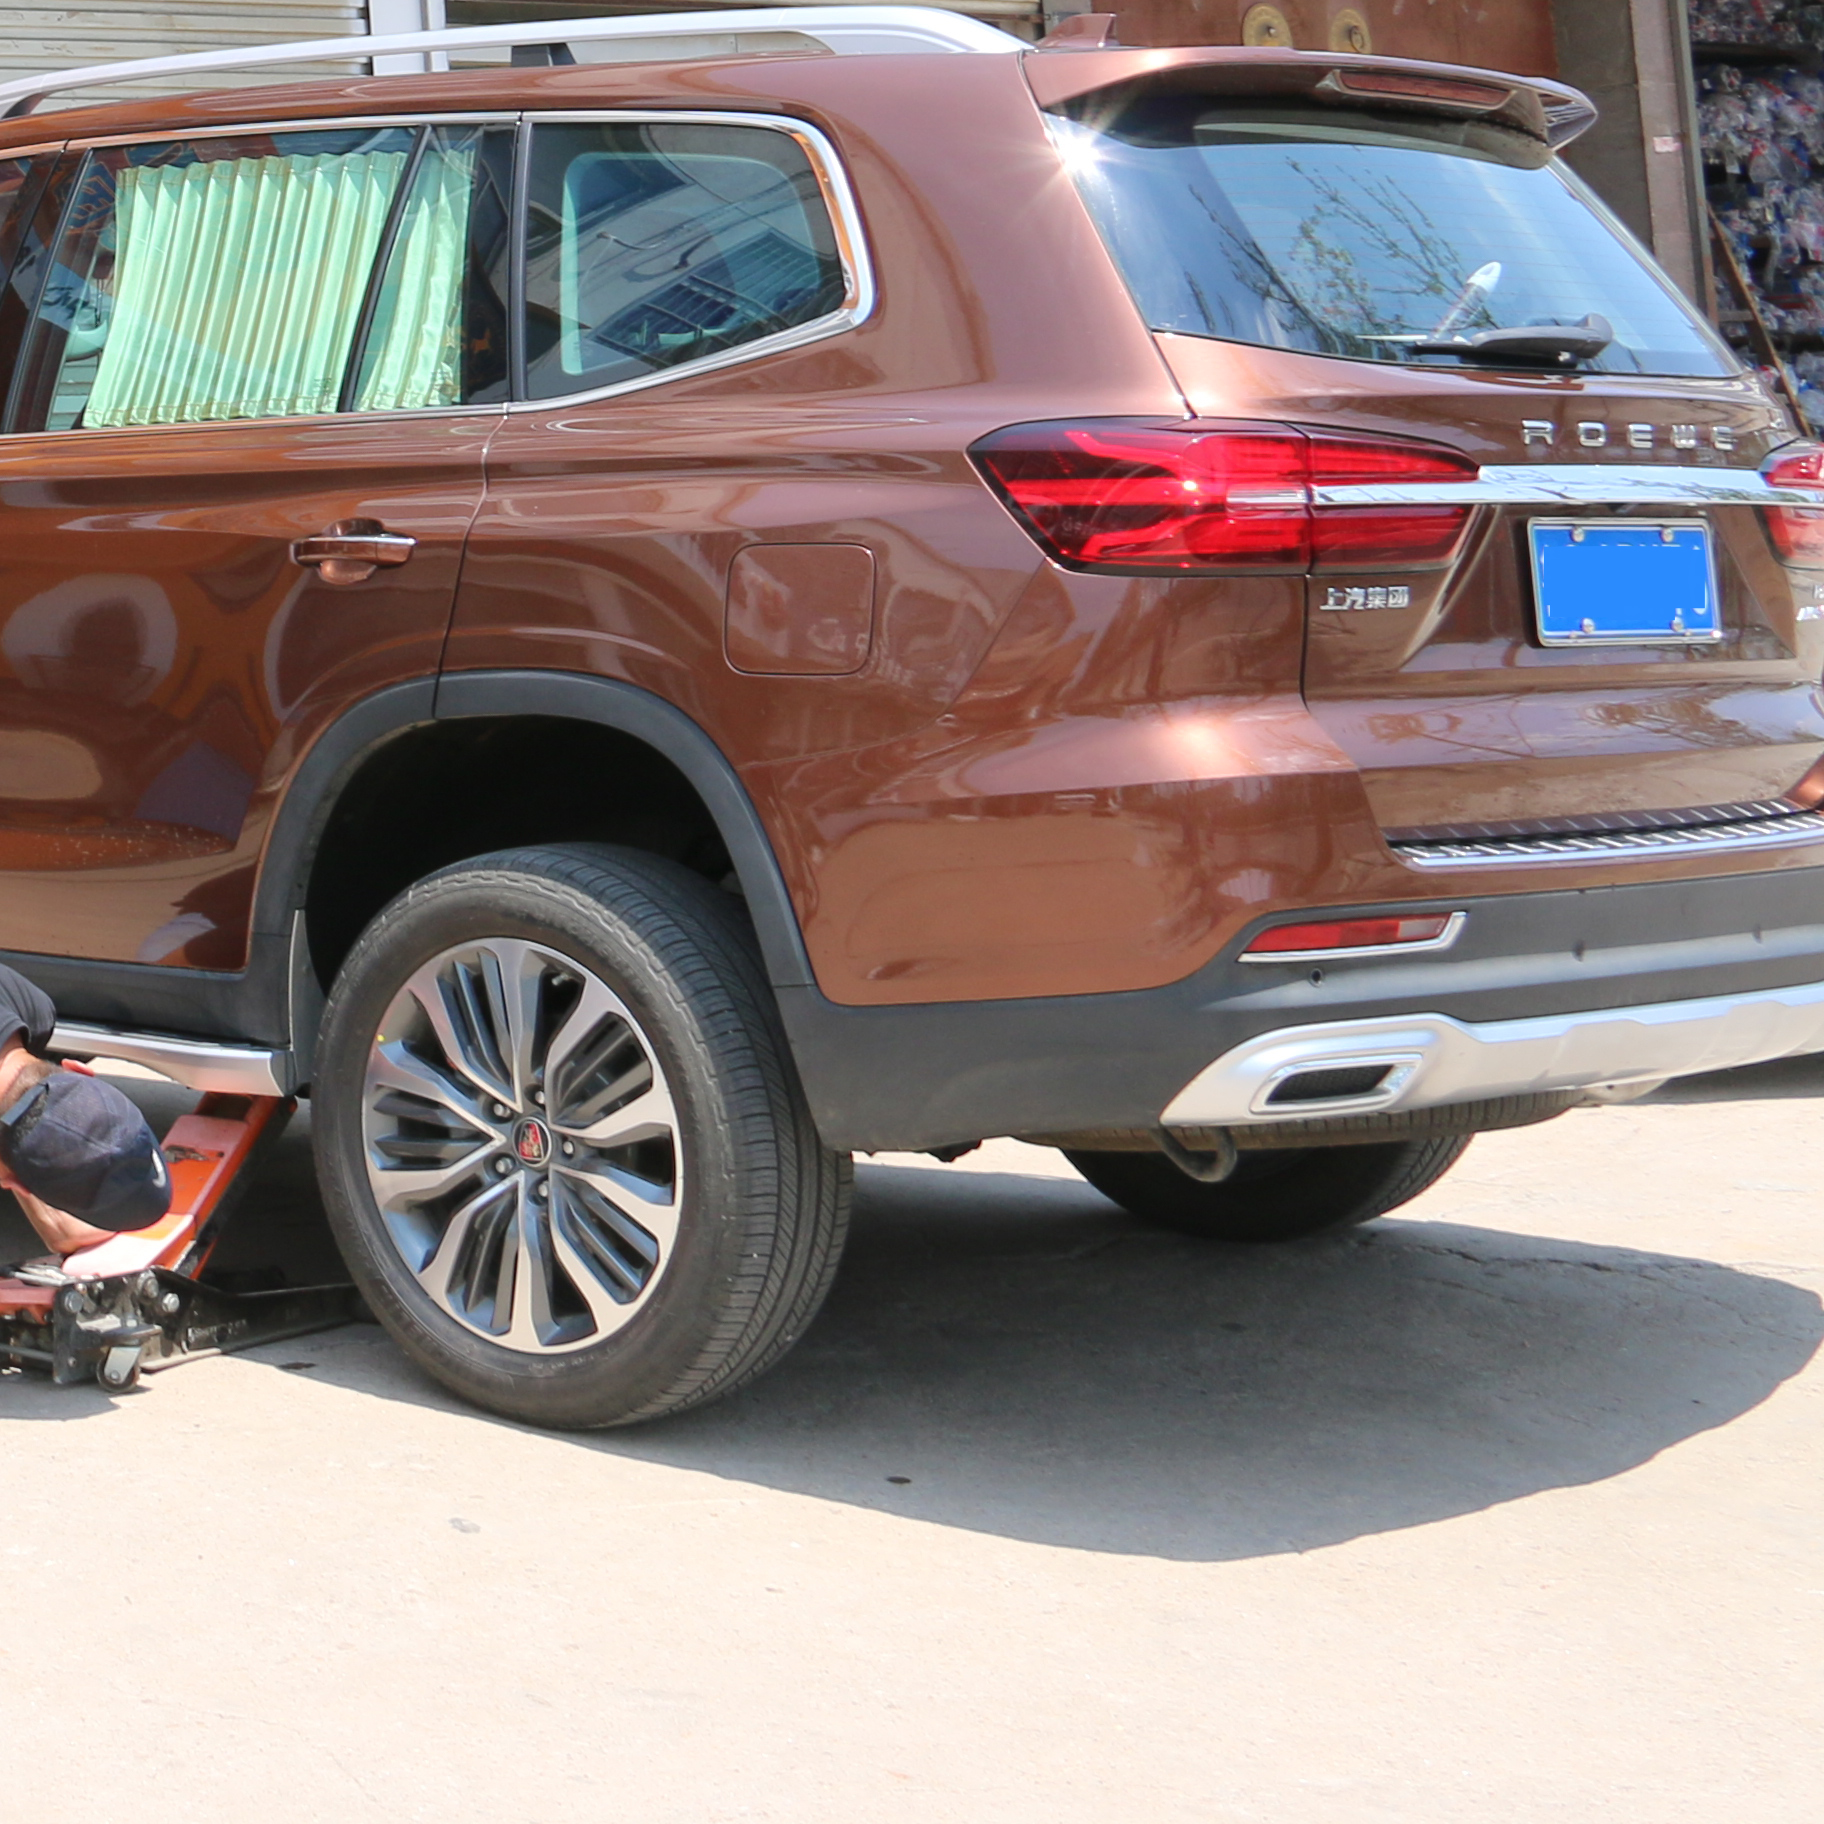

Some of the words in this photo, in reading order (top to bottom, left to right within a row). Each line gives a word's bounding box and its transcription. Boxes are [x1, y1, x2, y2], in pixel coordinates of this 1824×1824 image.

[1522, 419, 1738, 451] ROEWE
[1319, 586, 1410, 611] 上汽集团
